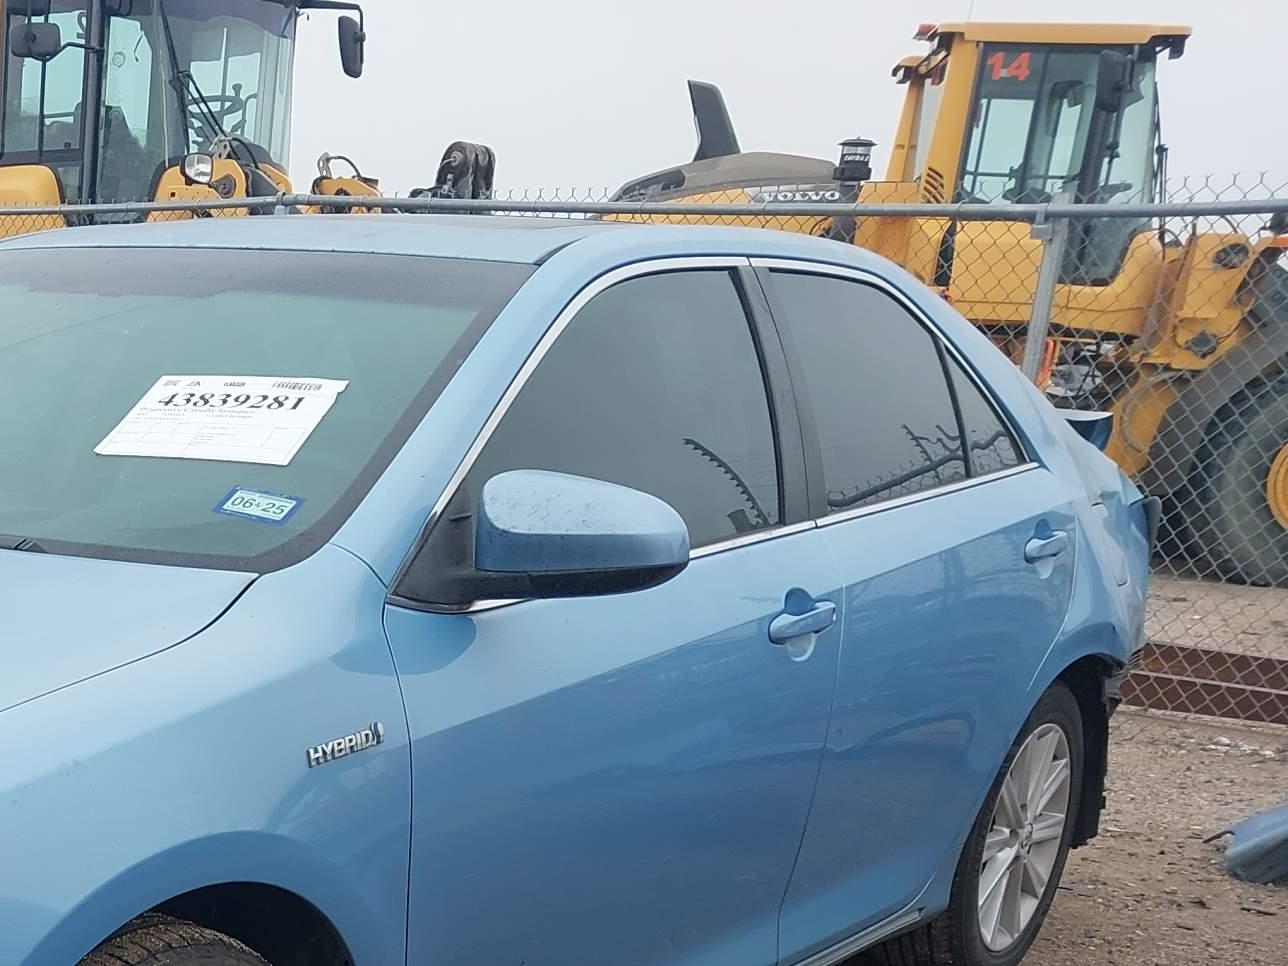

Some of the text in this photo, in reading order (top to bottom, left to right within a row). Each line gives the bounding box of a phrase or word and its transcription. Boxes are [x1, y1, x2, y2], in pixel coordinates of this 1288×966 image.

[987, 51, 1030, 80] 14
[762, 190, 840, 201] VOLVO
[158, 392, 306, 410] 43839281
[306, 729, 376, 768] HYBRID
